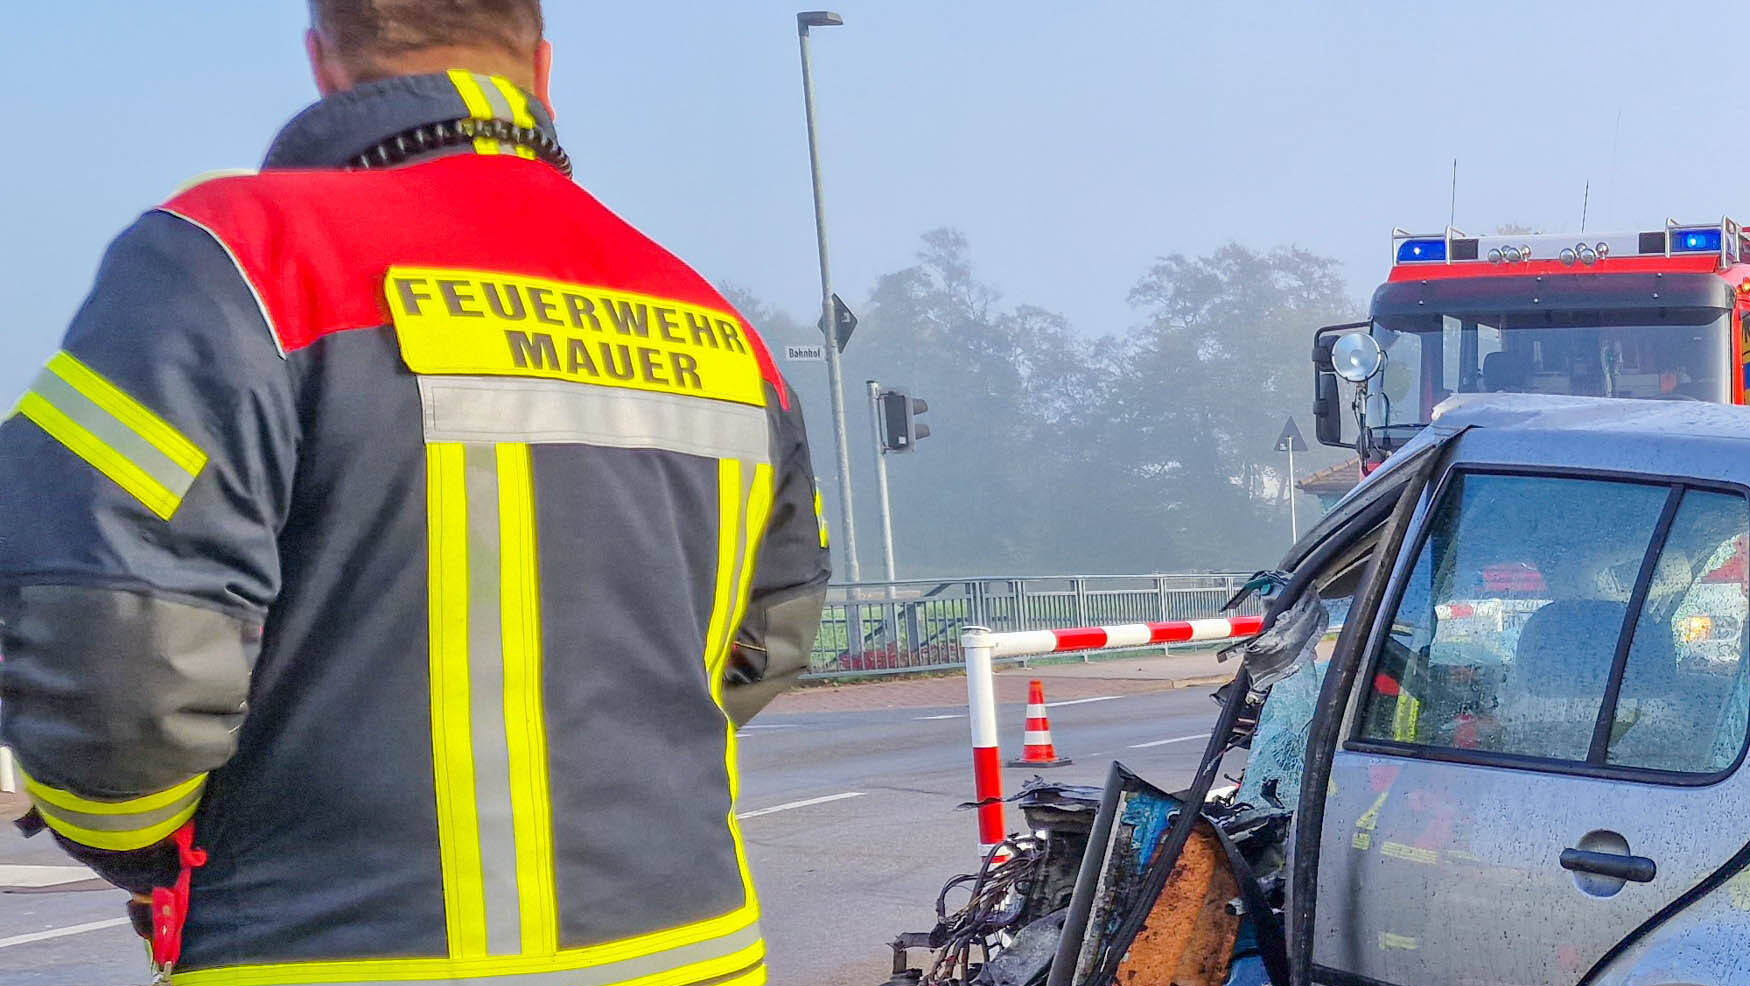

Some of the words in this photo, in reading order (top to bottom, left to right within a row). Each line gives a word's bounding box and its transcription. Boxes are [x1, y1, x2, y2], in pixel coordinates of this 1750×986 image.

[393, 277, 748, 354] FEUERWEHR
[504, 329, 704, 390] MAUER
[788, 348, 821, 359] Bahnhof
